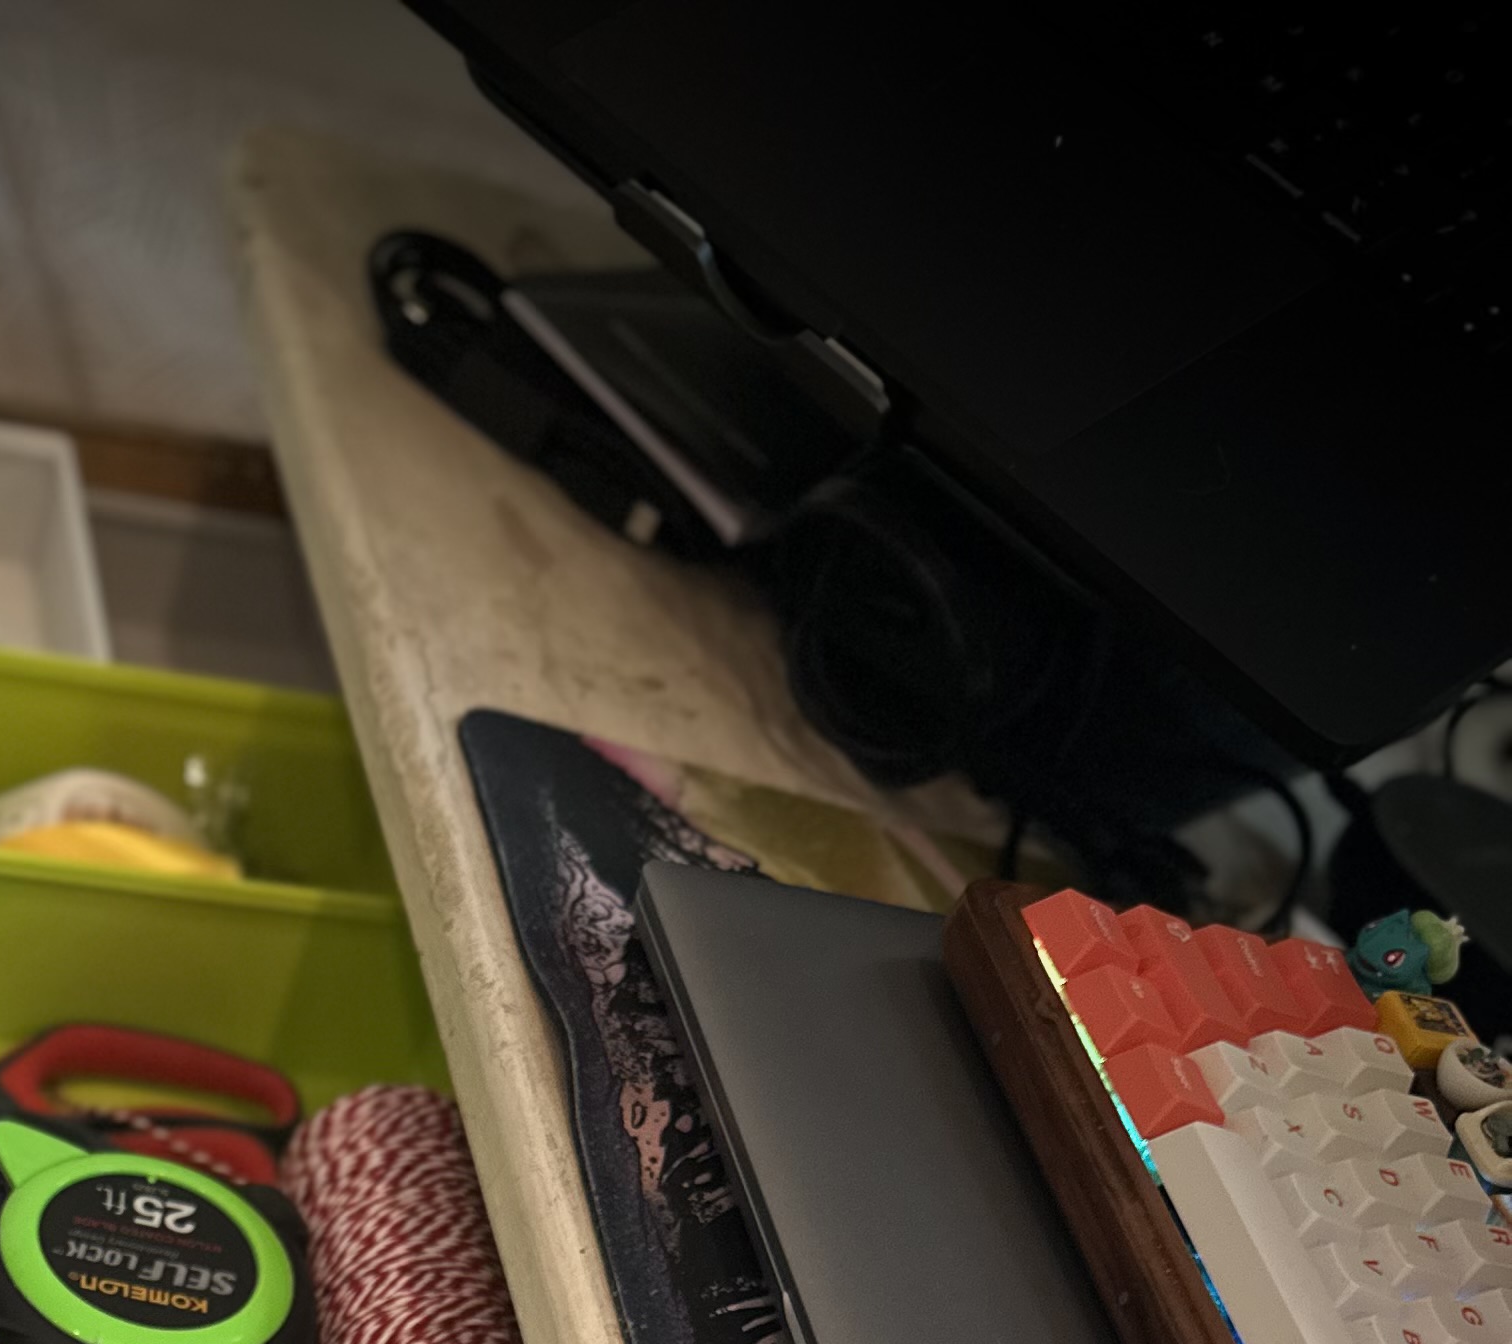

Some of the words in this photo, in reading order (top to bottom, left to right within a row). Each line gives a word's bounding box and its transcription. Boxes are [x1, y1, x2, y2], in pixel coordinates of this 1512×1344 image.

[1342, 1103, 1363, 1122] S
[1412, 1099, 1437, 1123] W
[1378, 1167, 1400, 1187] D
[1448, 1161, 1473, 1180] E
[1322, 1187, 1344, 1208] C
[132, 1195, 198, 1234] 25
[1417, 1234, 1440, 1253] F
[65, 1239, 139, 1271] LOCK
[138, 1259, 237, 1296] SELF
[78, 1274, 209, 1314] KOMELON
